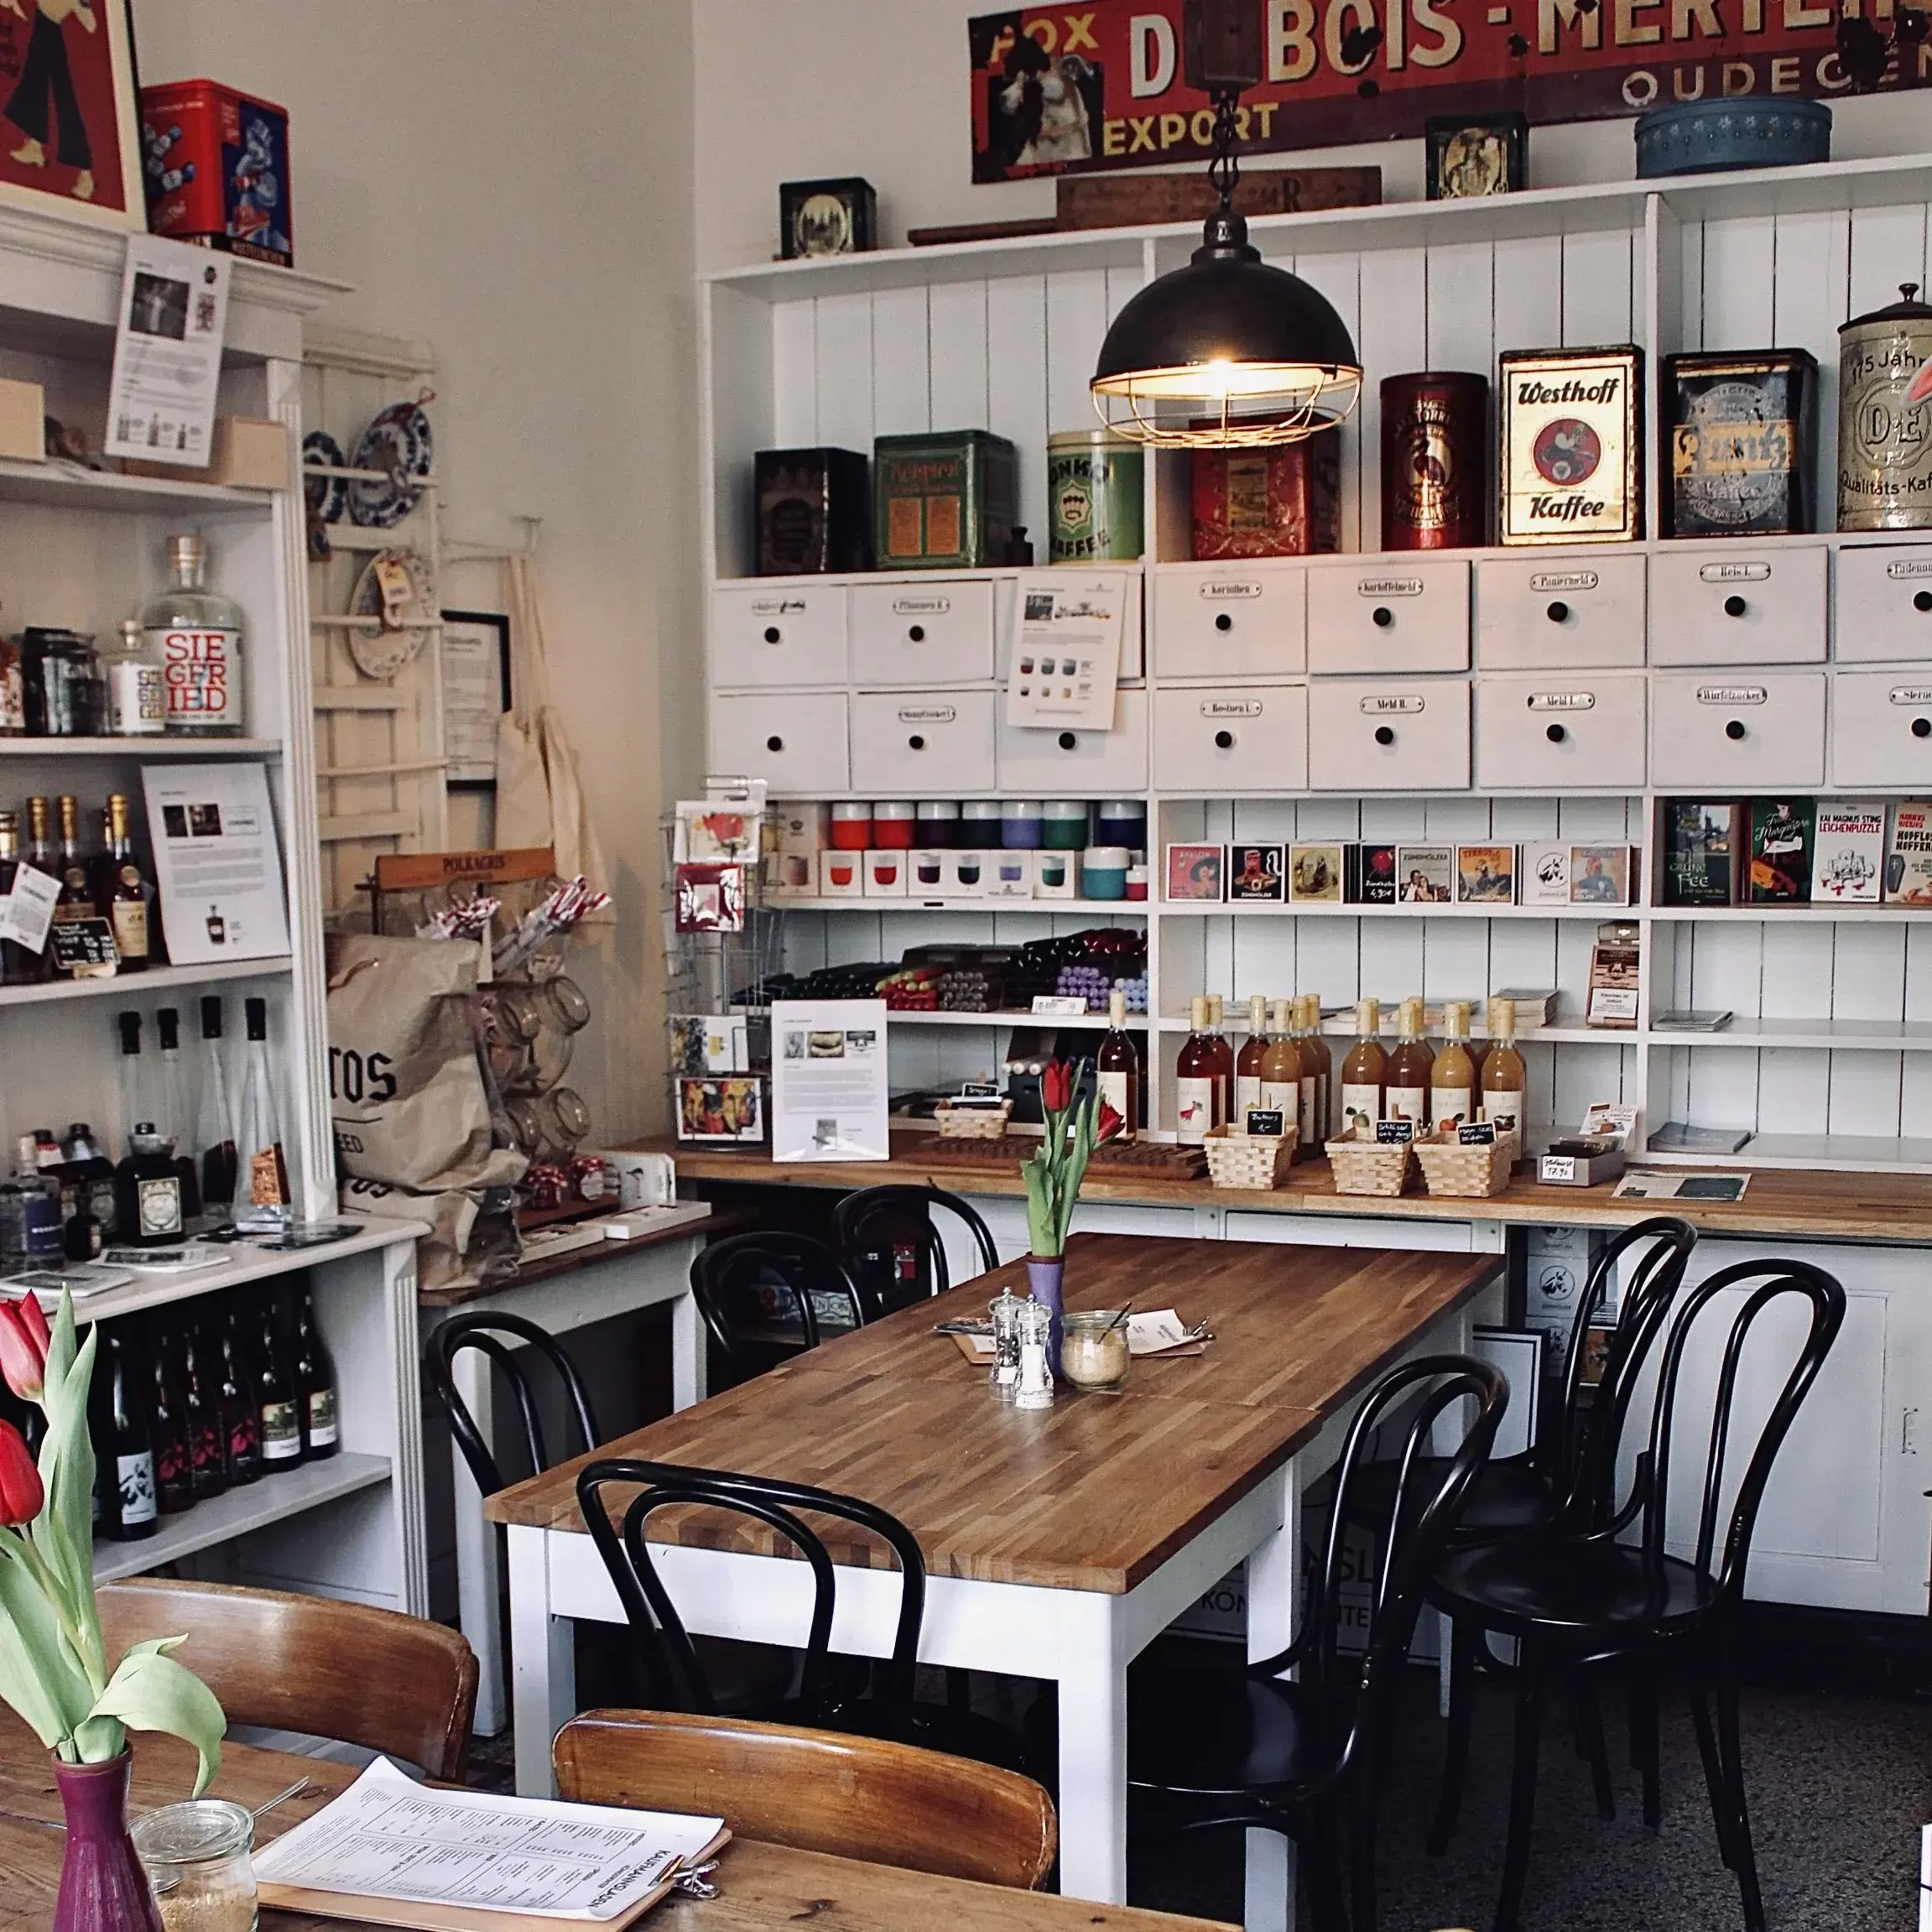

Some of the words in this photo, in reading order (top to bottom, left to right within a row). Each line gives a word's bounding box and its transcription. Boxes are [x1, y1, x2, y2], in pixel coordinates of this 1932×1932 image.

[1104, 103, 1278, 156] EXPORT
[1518, 378, 1620, 404] Westhoff
[1529, 496, 1604, 522] Kaffee
[165, 633, 226, 663] SIE
[164, 664, 227, 686] GFR
[167, 686, 227, 712] IED
[1819, 823, 1880, 833] LEICHENPUZZLE
